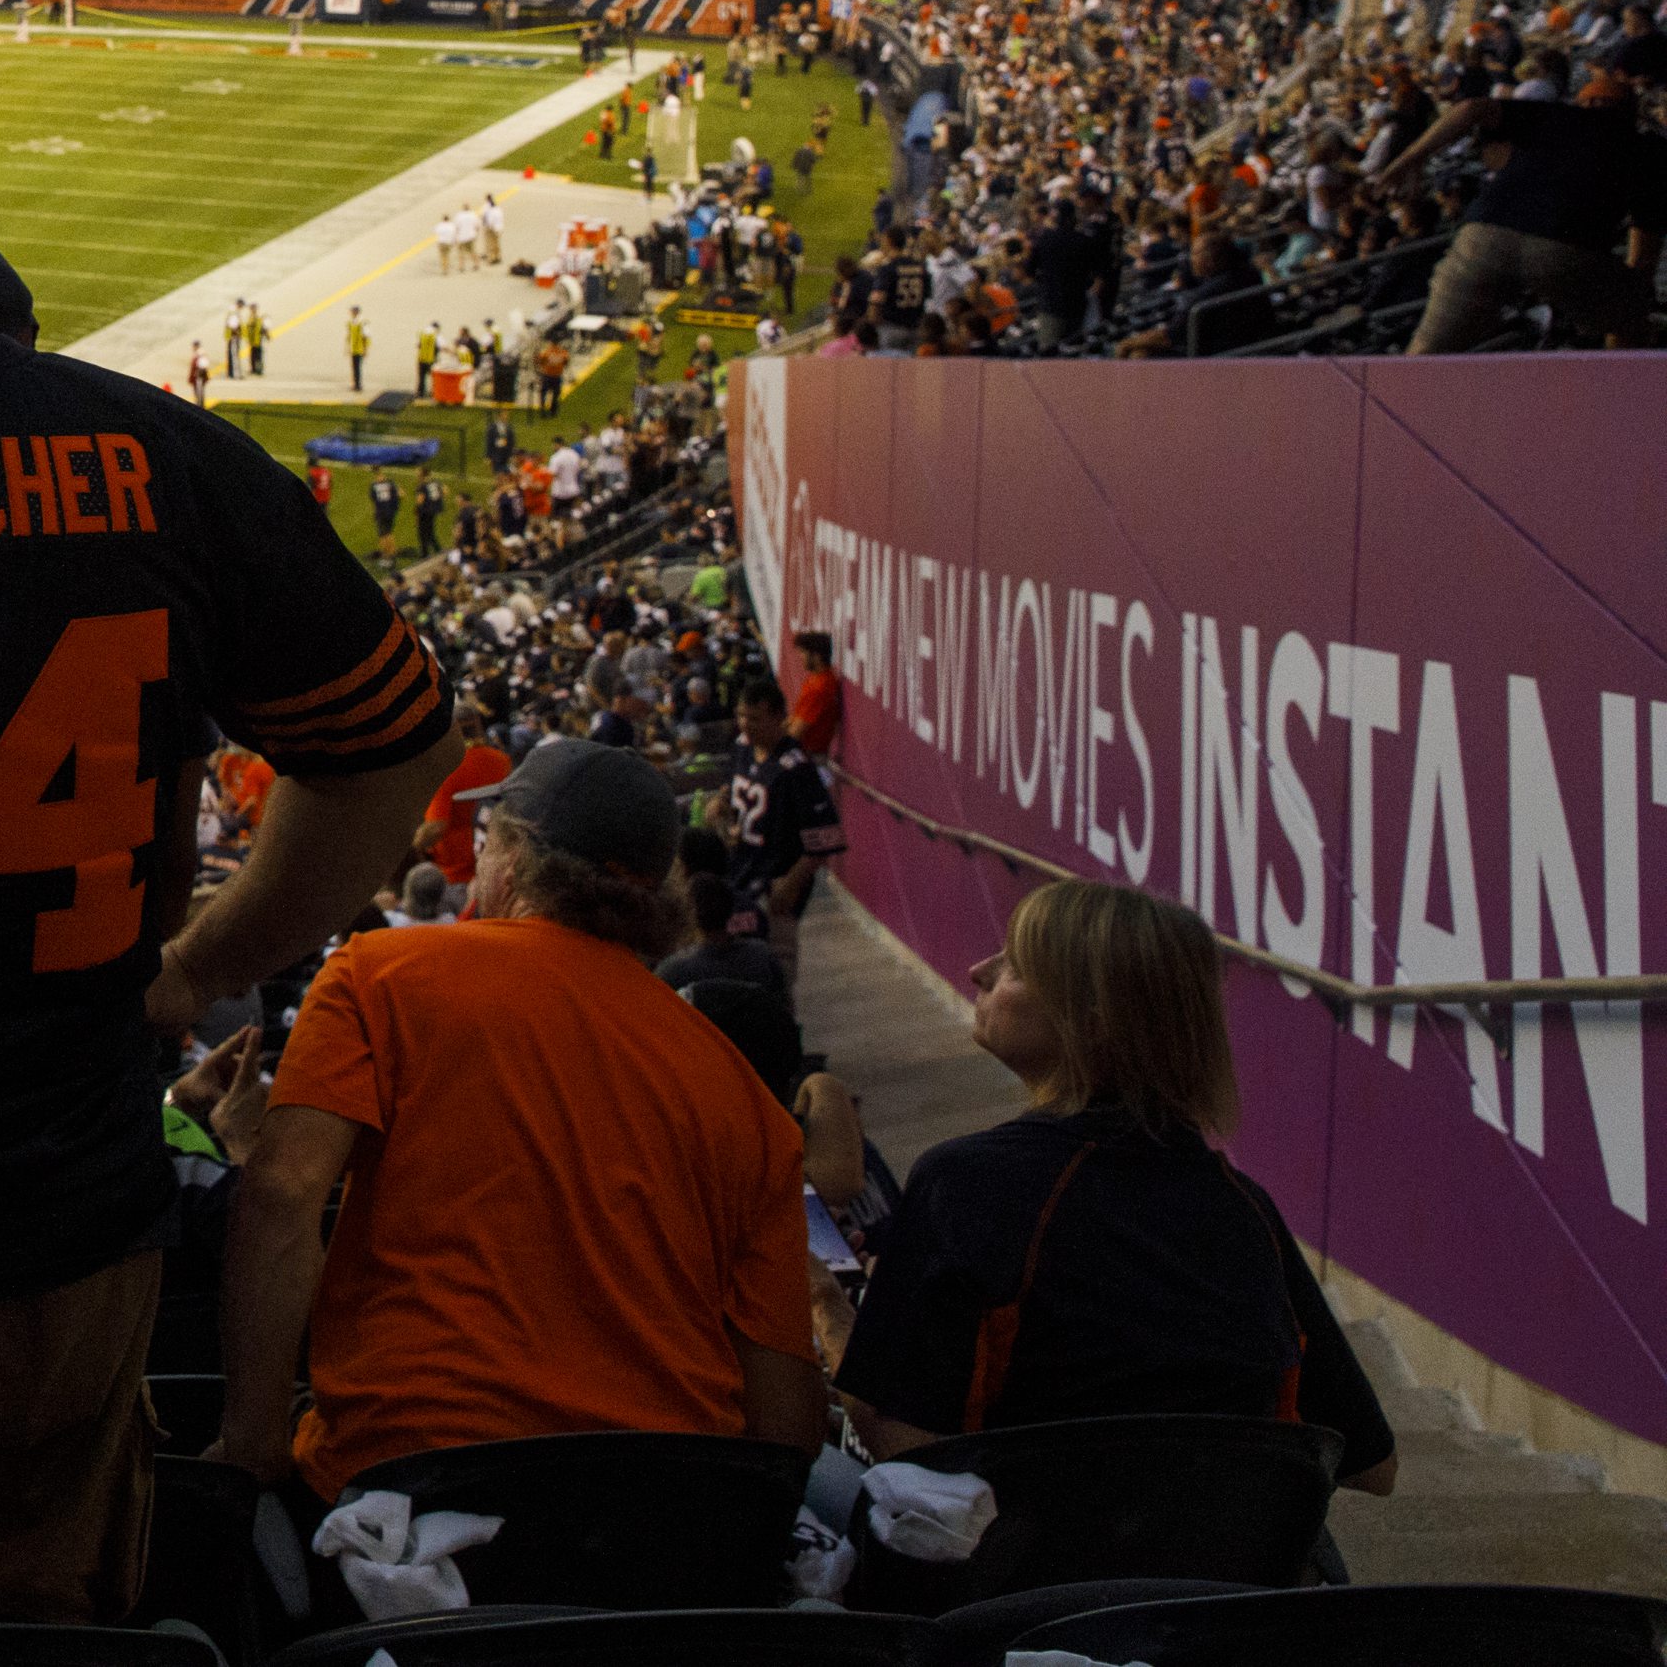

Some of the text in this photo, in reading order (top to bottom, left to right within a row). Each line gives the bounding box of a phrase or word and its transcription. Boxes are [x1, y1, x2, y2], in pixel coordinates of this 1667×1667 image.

[731, 773, 768, 847] 52
[813, 517, 893, 712] STREAM
[899, 545, 969, 762] NEW
[977, 569, 1155, 885] MOVIES
[1179, 611, 1667, 1225] INSTAN
